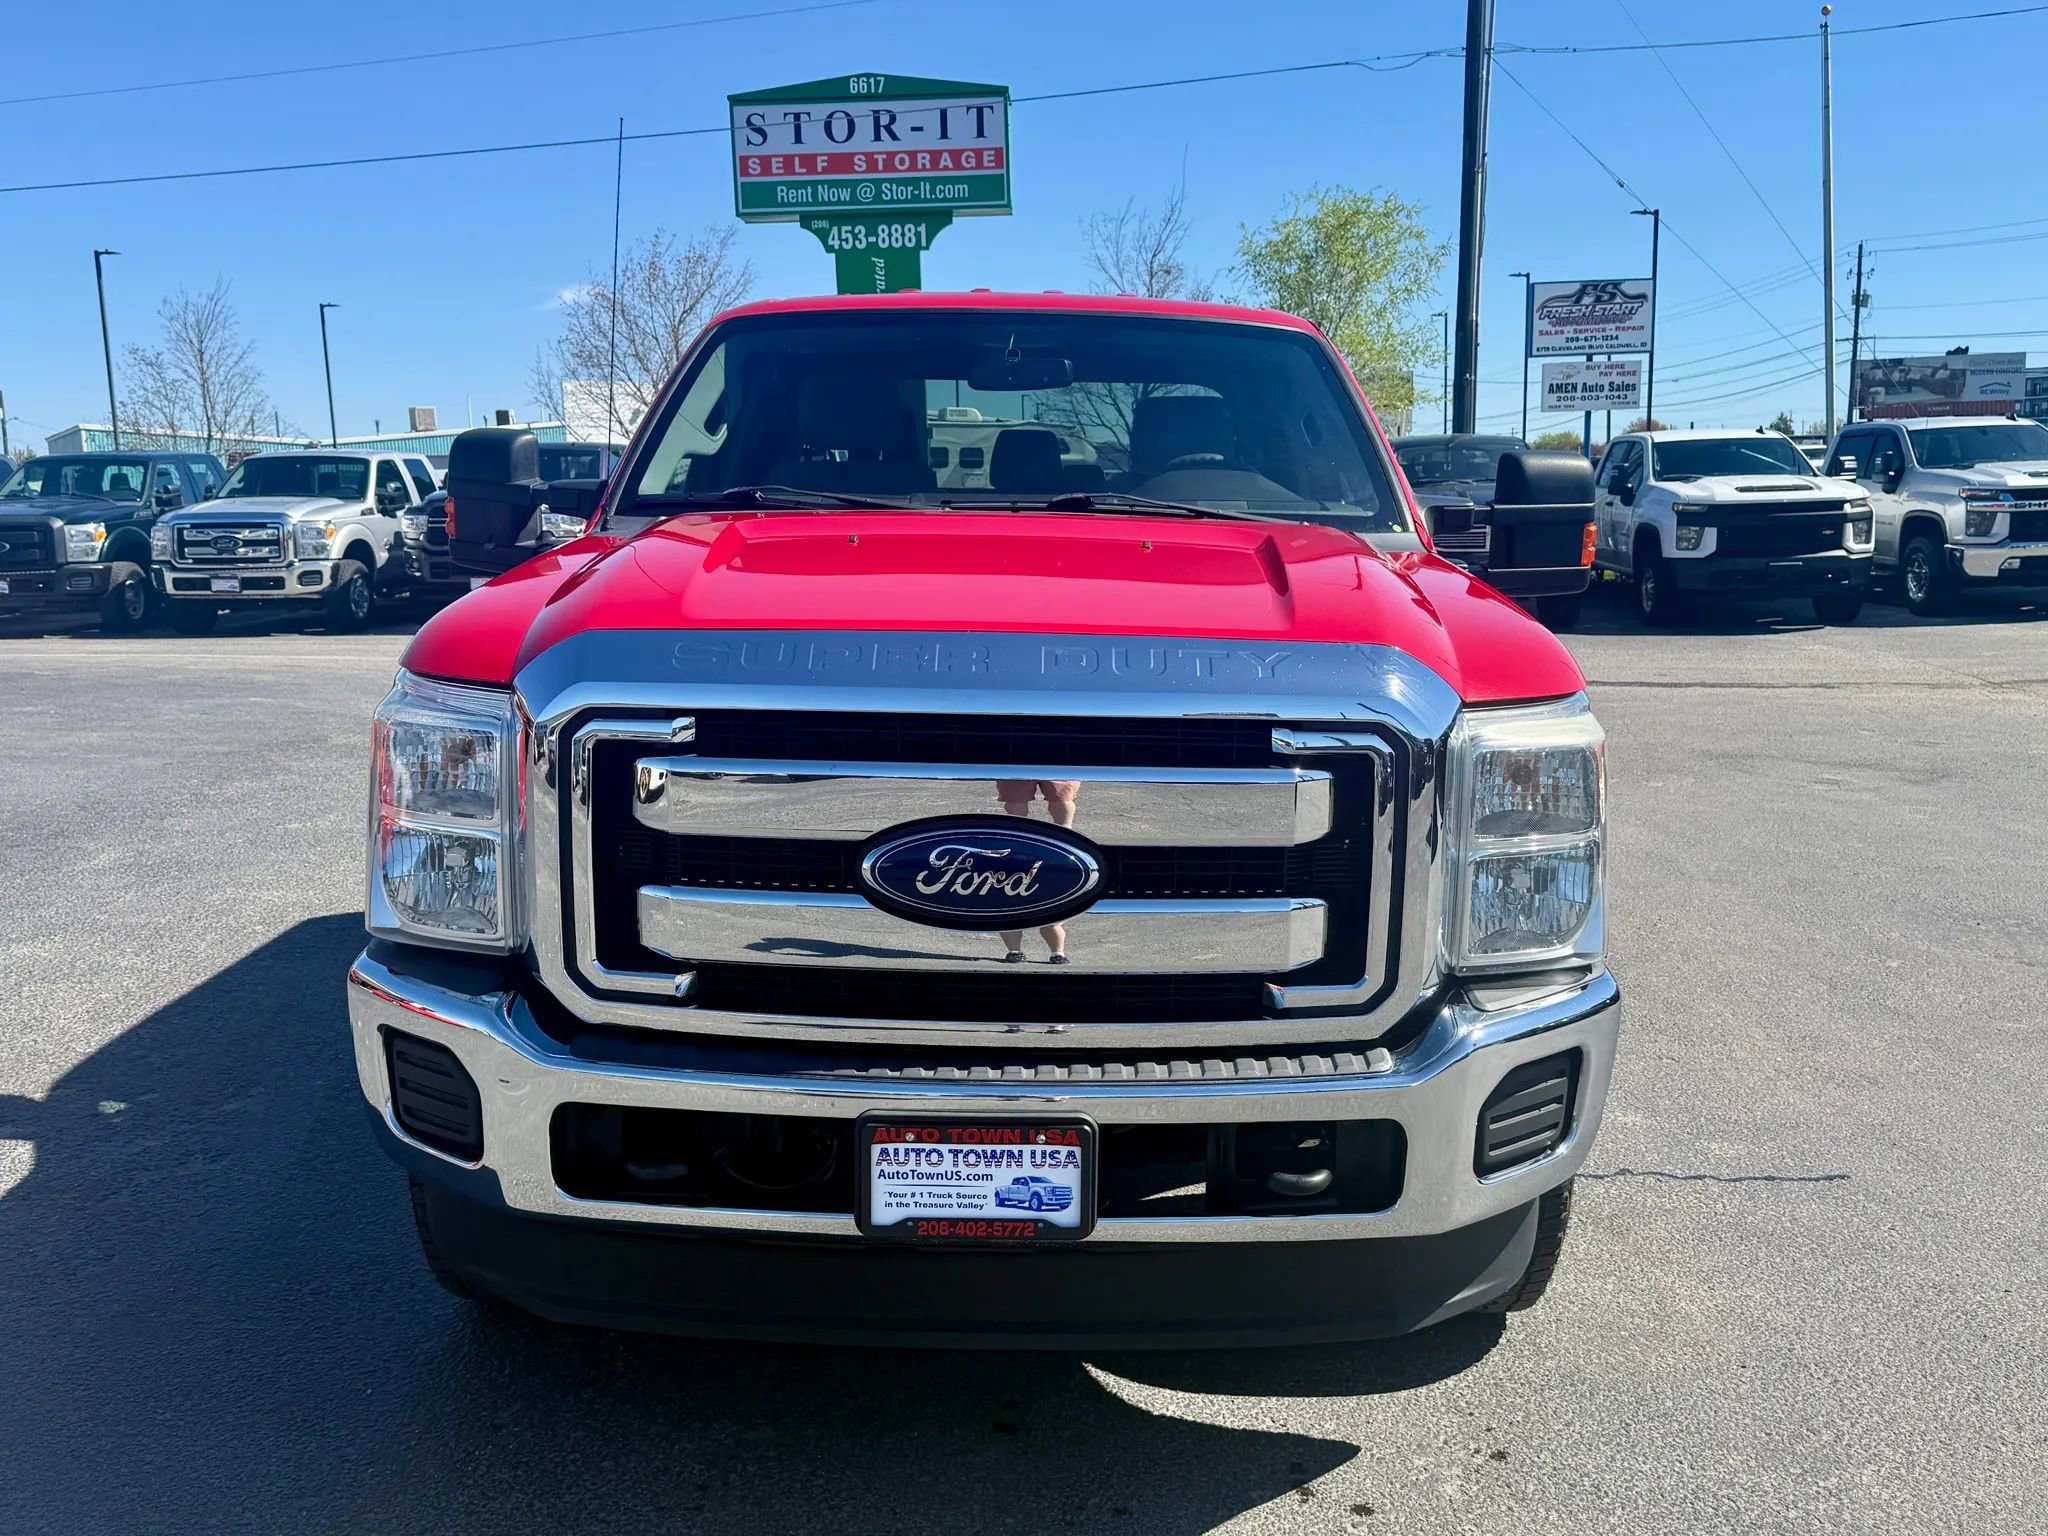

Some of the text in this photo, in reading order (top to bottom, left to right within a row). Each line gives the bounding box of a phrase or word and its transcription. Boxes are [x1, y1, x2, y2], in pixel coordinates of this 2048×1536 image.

[850, 77, 885, 94] 6617
[744, 104, 994, 147] STOR-IT
[748, 150, 996, 175] SELF STORAGE
[777, 181, 969, 203] Rent Now @ Stor-It.com
[828, 223, 927, 250] 453-8881
[1538, 300, 1644, 321] FRESH START
[1572, 327, 1607, 335] SERVICE
[1615, 325, 1645, 333] REPAIR
[1547, 381, 1637, 394] AMEN Auto Sales
[672, 640, 1293, 679] SUPER DUTY
[915, 845, 1043, 897] Ford
[872, 1127, 1081, 1146] AUTO TOWN USA
[875, 1147, 1081, 1169] AUTO TOWN USA
[877, 1169, 993, 1182] AutoTownUS.com
[910, 1191, 916, 1199] #
[956, 1192, 988, 1200] Source
[913, 1201, 953, 1209] Treasure
[917, 1221, 1035, 1237] 208-402-5772
